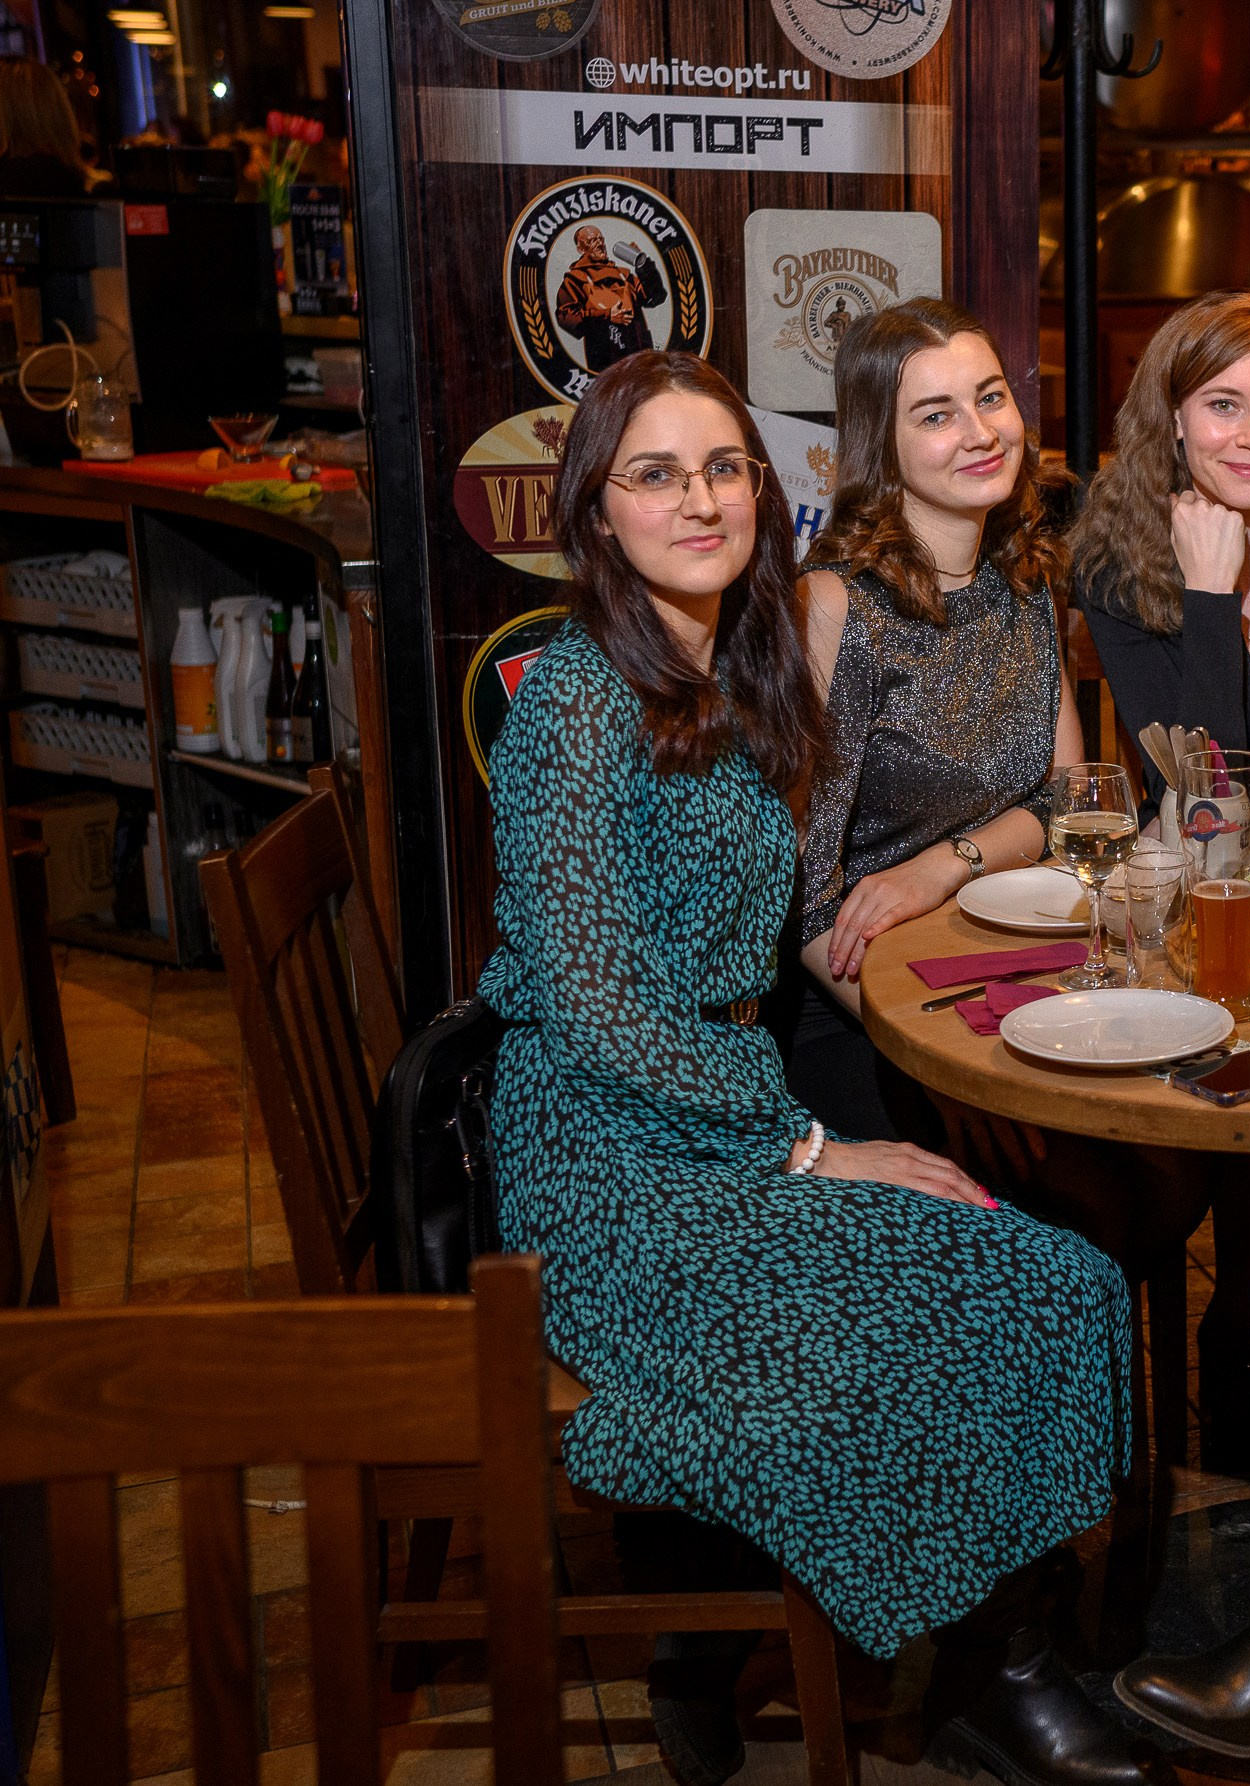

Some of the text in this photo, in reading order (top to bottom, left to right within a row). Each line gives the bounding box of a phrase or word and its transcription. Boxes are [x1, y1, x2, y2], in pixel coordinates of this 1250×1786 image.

[469, 4, 509, 20] GRUIT
[619, 57, 811, 95] whiteopt.ru
[574, 110, 824, 156] ИМПОРТ
[517, 185, 678, 259] Franziskaner
[773, 248, 900, 309] BAYREUTHER
[835, 282, 874, 313] BIERBRAUE
[480, 475, 556, 542] VE
